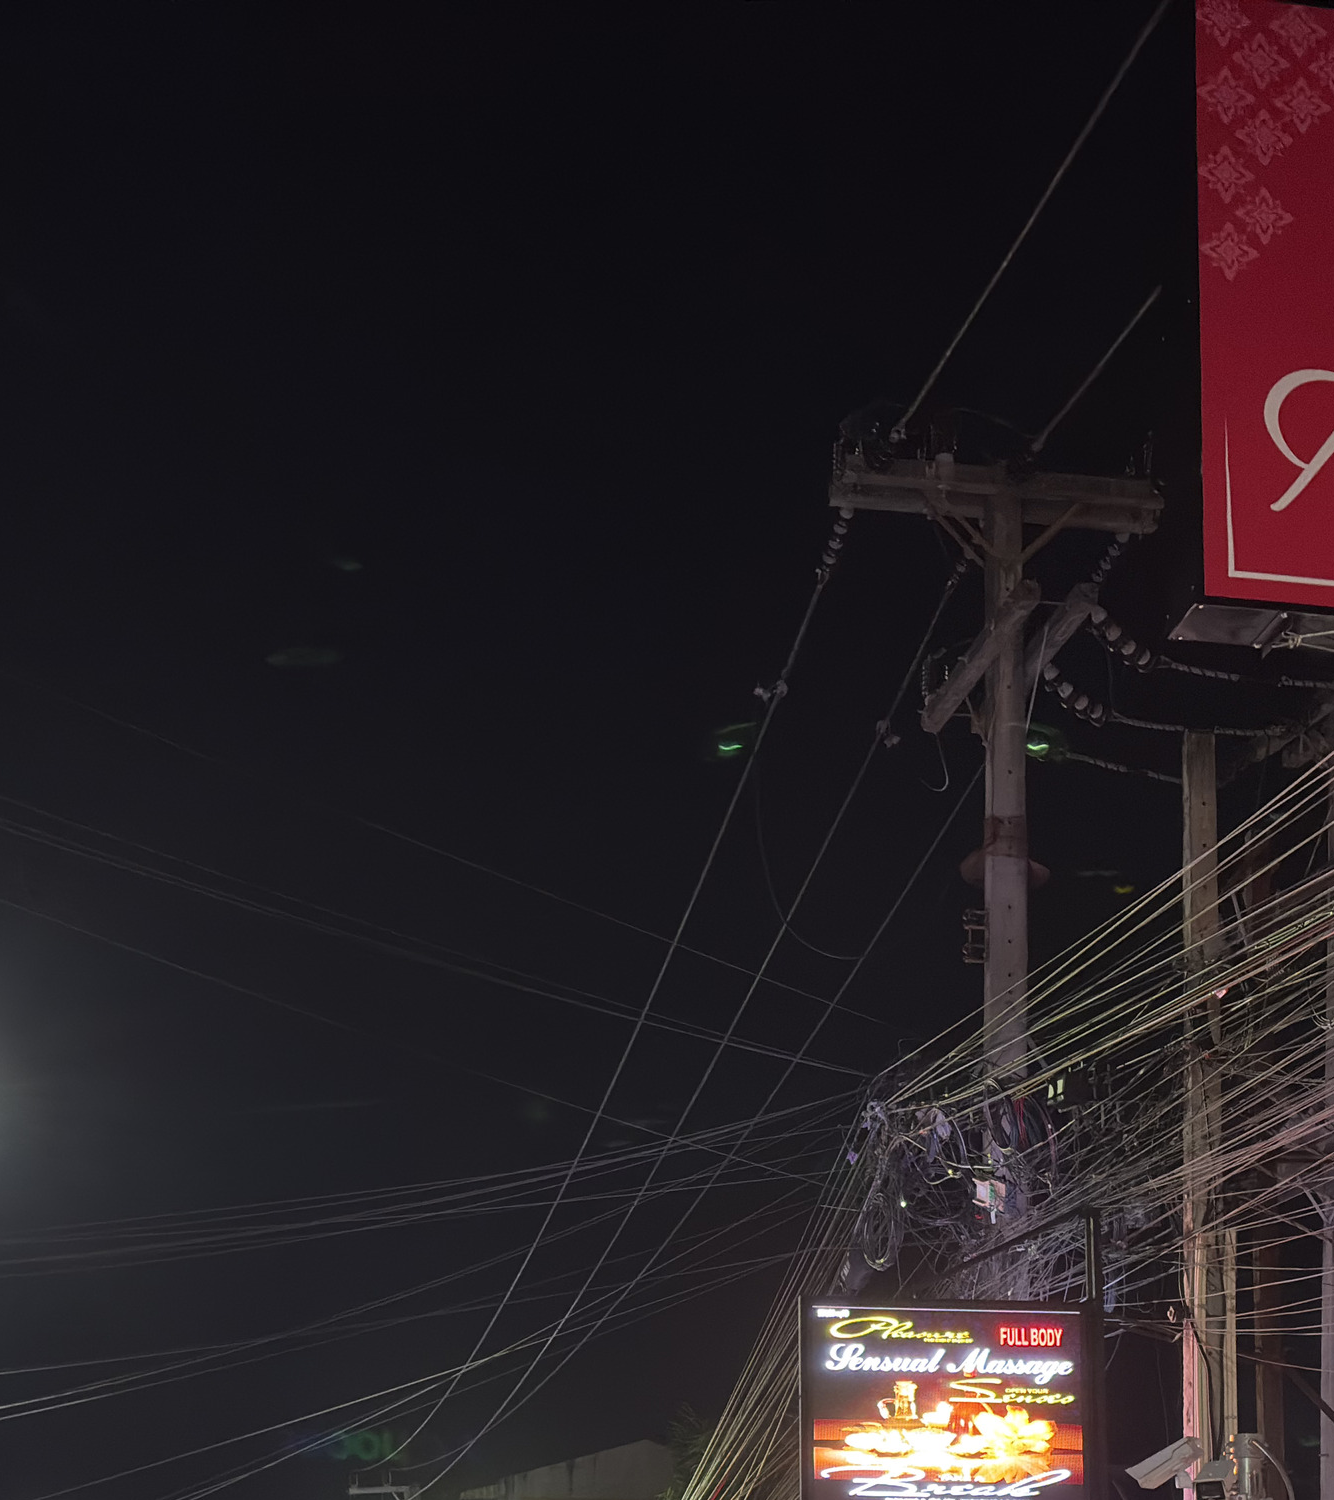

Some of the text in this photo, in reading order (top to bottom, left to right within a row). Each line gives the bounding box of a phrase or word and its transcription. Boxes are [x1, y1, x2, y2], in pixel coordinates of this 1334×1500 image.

[1000, 1327, 1063, 1347] FULL BODY
[825, 1344, 1074, 1385] Sensual Massage
